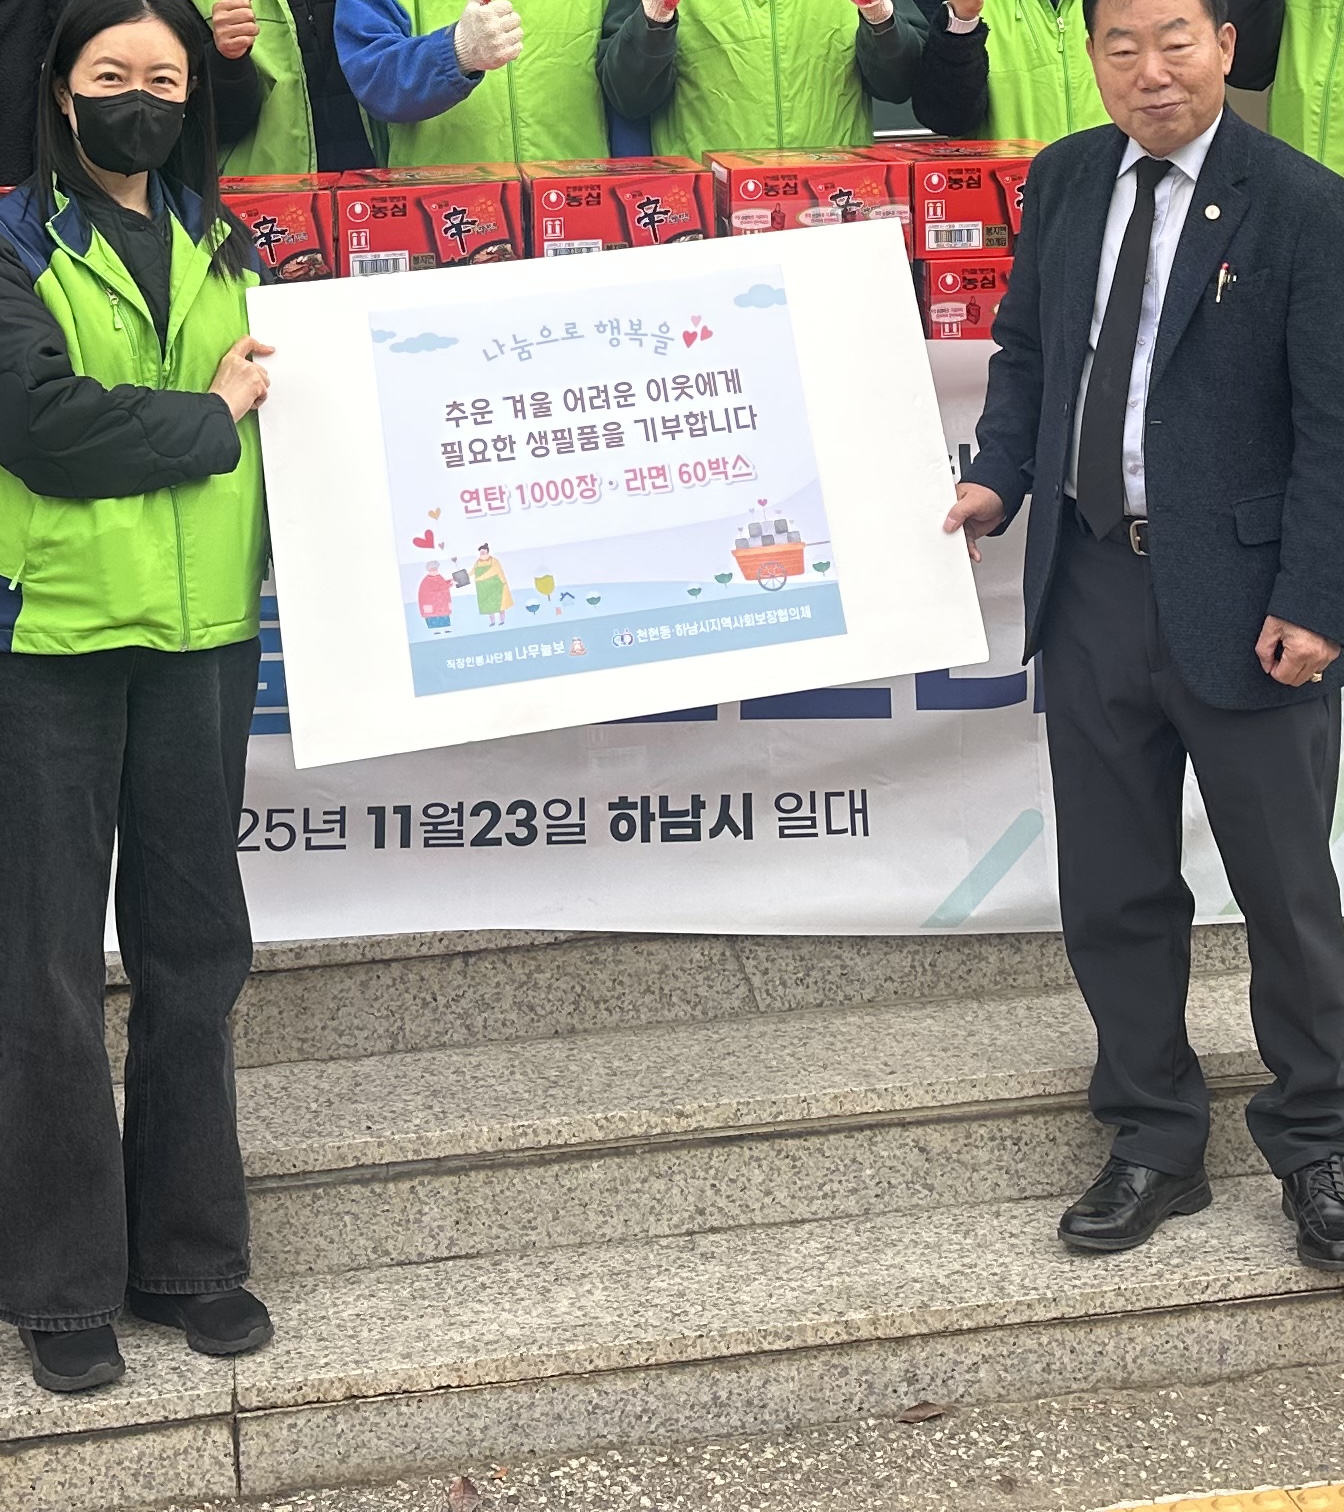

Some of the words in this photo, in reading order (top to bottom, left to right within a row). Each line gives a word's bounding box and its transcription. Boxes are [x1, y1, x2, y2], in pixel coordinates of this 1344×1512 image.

[566, 192, 602, 208] 농심
[764, 182, 798, 197] 농심
[947, 175, 982, 190] 농심
[370, 203, 408, 220] 농심
[442, 206, 477, 255] 辛
[635, 194, 671, 245] 辛
[962, 274, 996, 290] 농심
[482, 322, 585, 362] 나눔으로
[594, 318, 675, 356] 행복을
[445, 398, 494, 428] 추운
[502, 390, 553, 420] 겨울
[563, 380, 636, 414] 어려운
[646, 368, 743, 404] 이웃에게
[440, 434, 516, 469] 필요한
[526, 420, 625, 458] 생필품을
[634, 404, 758, 443] 기부합니다
[460, 484, 506, 514] 연탄
[515, 473, 598, 505] 1000장
[624, 464, 669, 493] 라면
[678, 454, 754, 484] 60박스
[446, 649, 514, 670] 직장인봉사단체
[515, 640, 566, 662] 나무늘보
[236, 805, 348, 852] 25년
[366, 797, 588, 850] 11월23일
[608, 792, 754, 843] 하남시
[774, 789, 870, 840] 일대
